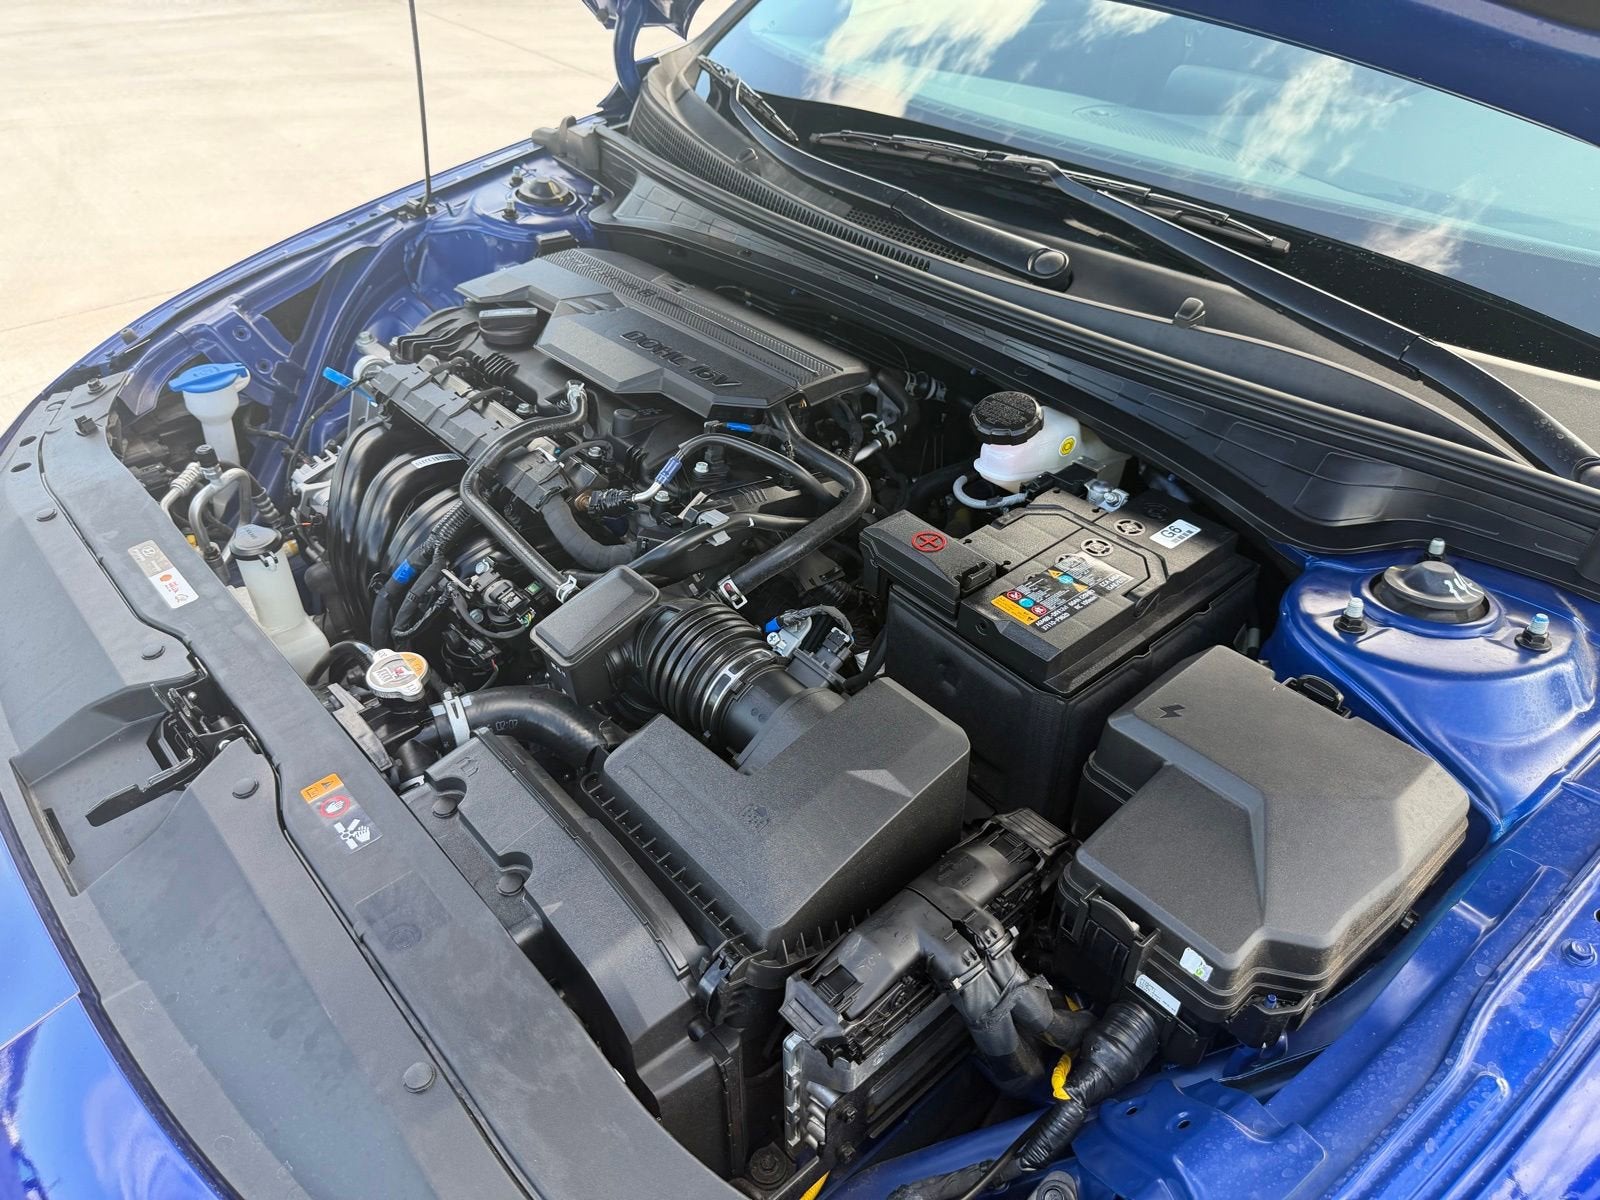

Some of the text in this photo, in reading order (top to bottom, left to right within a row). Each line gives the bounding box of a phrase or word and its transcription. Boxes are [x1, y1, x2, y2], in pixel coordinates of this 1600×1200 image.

[619, 330, 744, 387] DOHC 16V
[1160, 525, 1182, 538] G6
